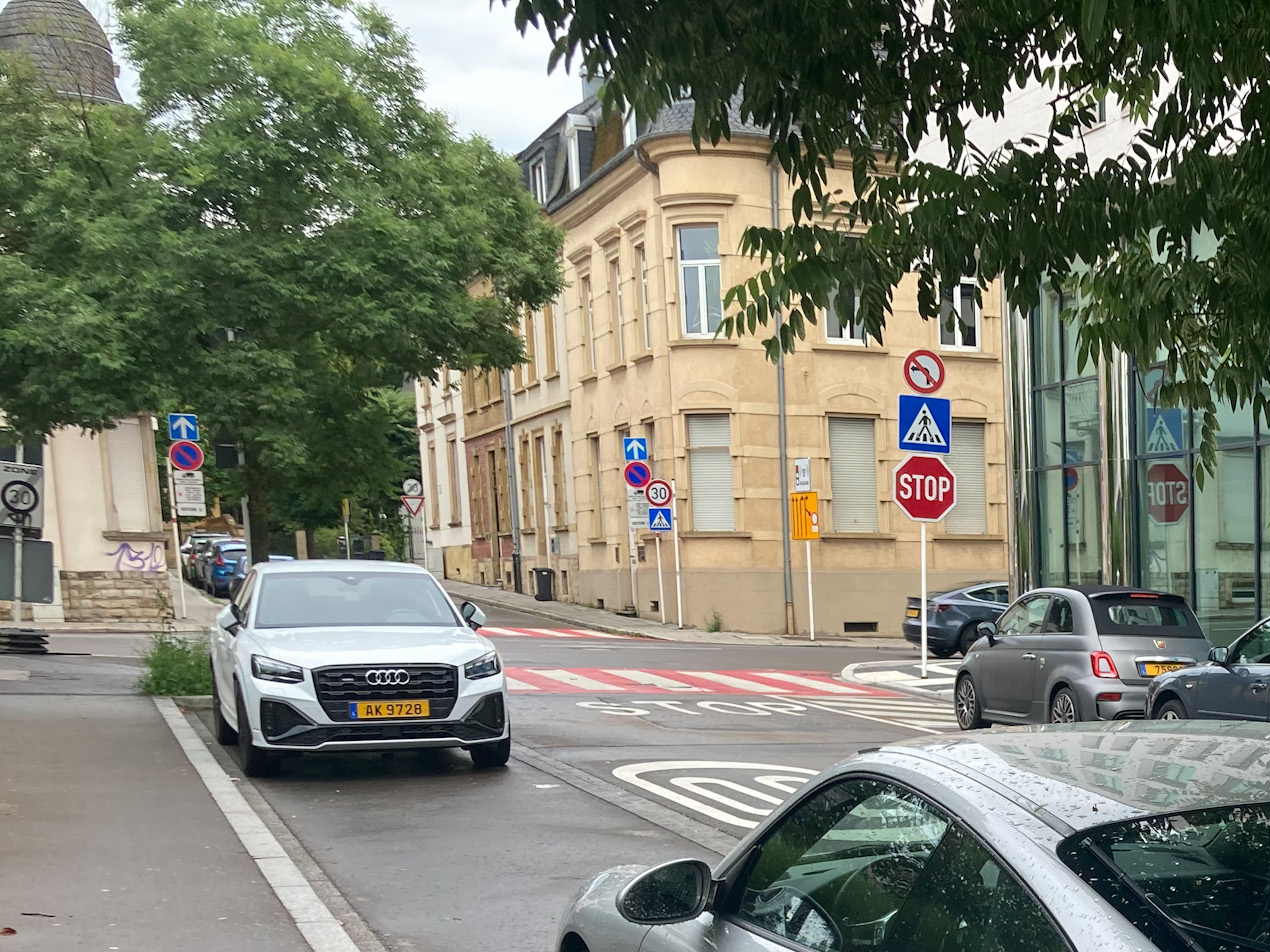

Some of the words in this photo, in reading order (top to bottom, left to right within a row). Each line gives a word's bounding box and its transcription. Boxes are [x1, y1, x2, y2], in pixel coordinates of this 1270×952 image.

[3, 466, 38, 476] ZONE
[407, 483, 419, 493] 30
[651, 487, 667, 499] 30
[899, 473, 951, 502] STOP
[9, 489, 32, 505] 30
[366, 704, 383, 716] AK
[386, 703, 422, 716] 9728
[574, 699, 808, 717] STOP
